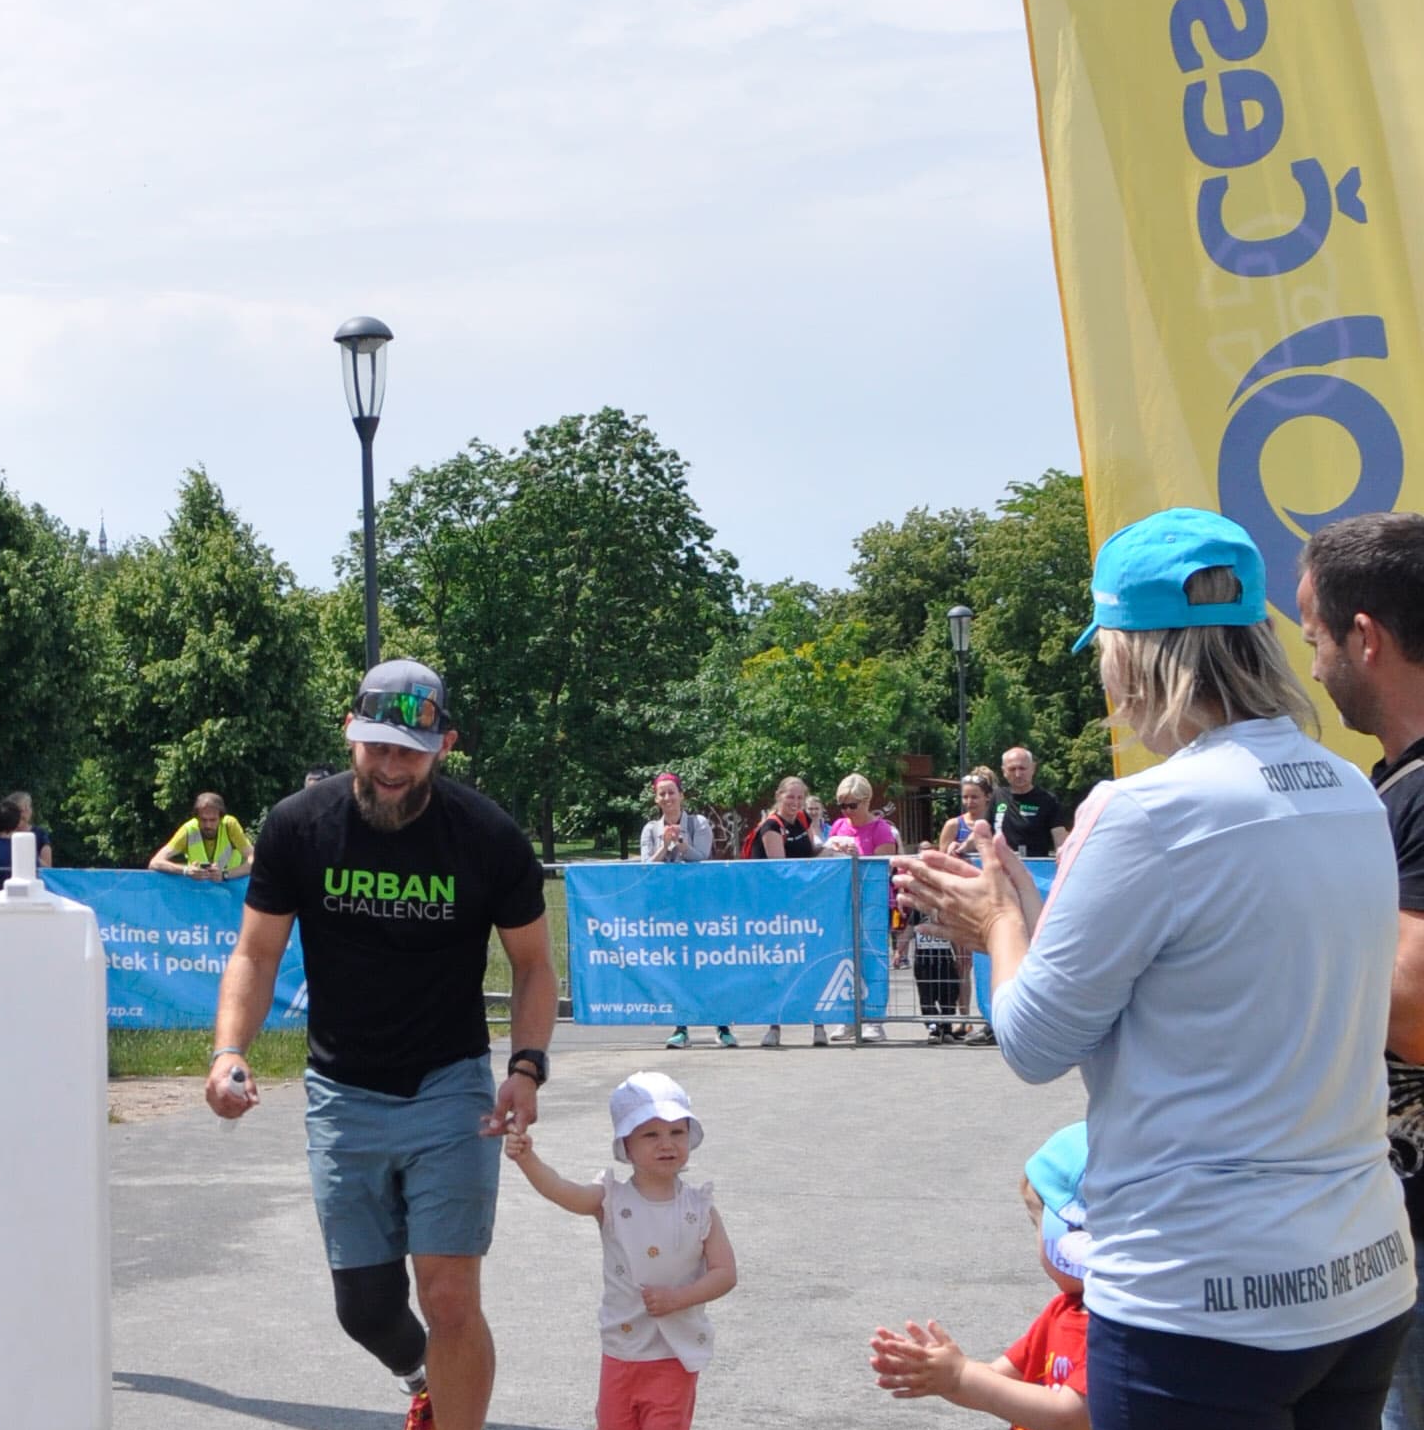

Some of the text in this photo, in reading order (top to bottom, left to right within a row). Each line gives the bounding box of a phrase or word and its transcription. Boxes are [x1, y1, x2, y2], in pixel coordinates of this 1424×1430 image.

[324, 867, 455, 903] URBAN
[323, 895, 455, 920] CHALLENGE
[100, 923, 160, 945] stíme
[166, 925, 209, 946] vaši
[587, 916, 824, 941] Pojistíme vaši rodinu,
[105, 950, 226, 976] etek i podni
[589, 943, 806, 969] majetek i podnikání
[590, 1002, 673, 1016] www.pvzp.cz
[1203, 1229, 1409, 1313] ALL RUNNERS ARE BEAUTIFUL
